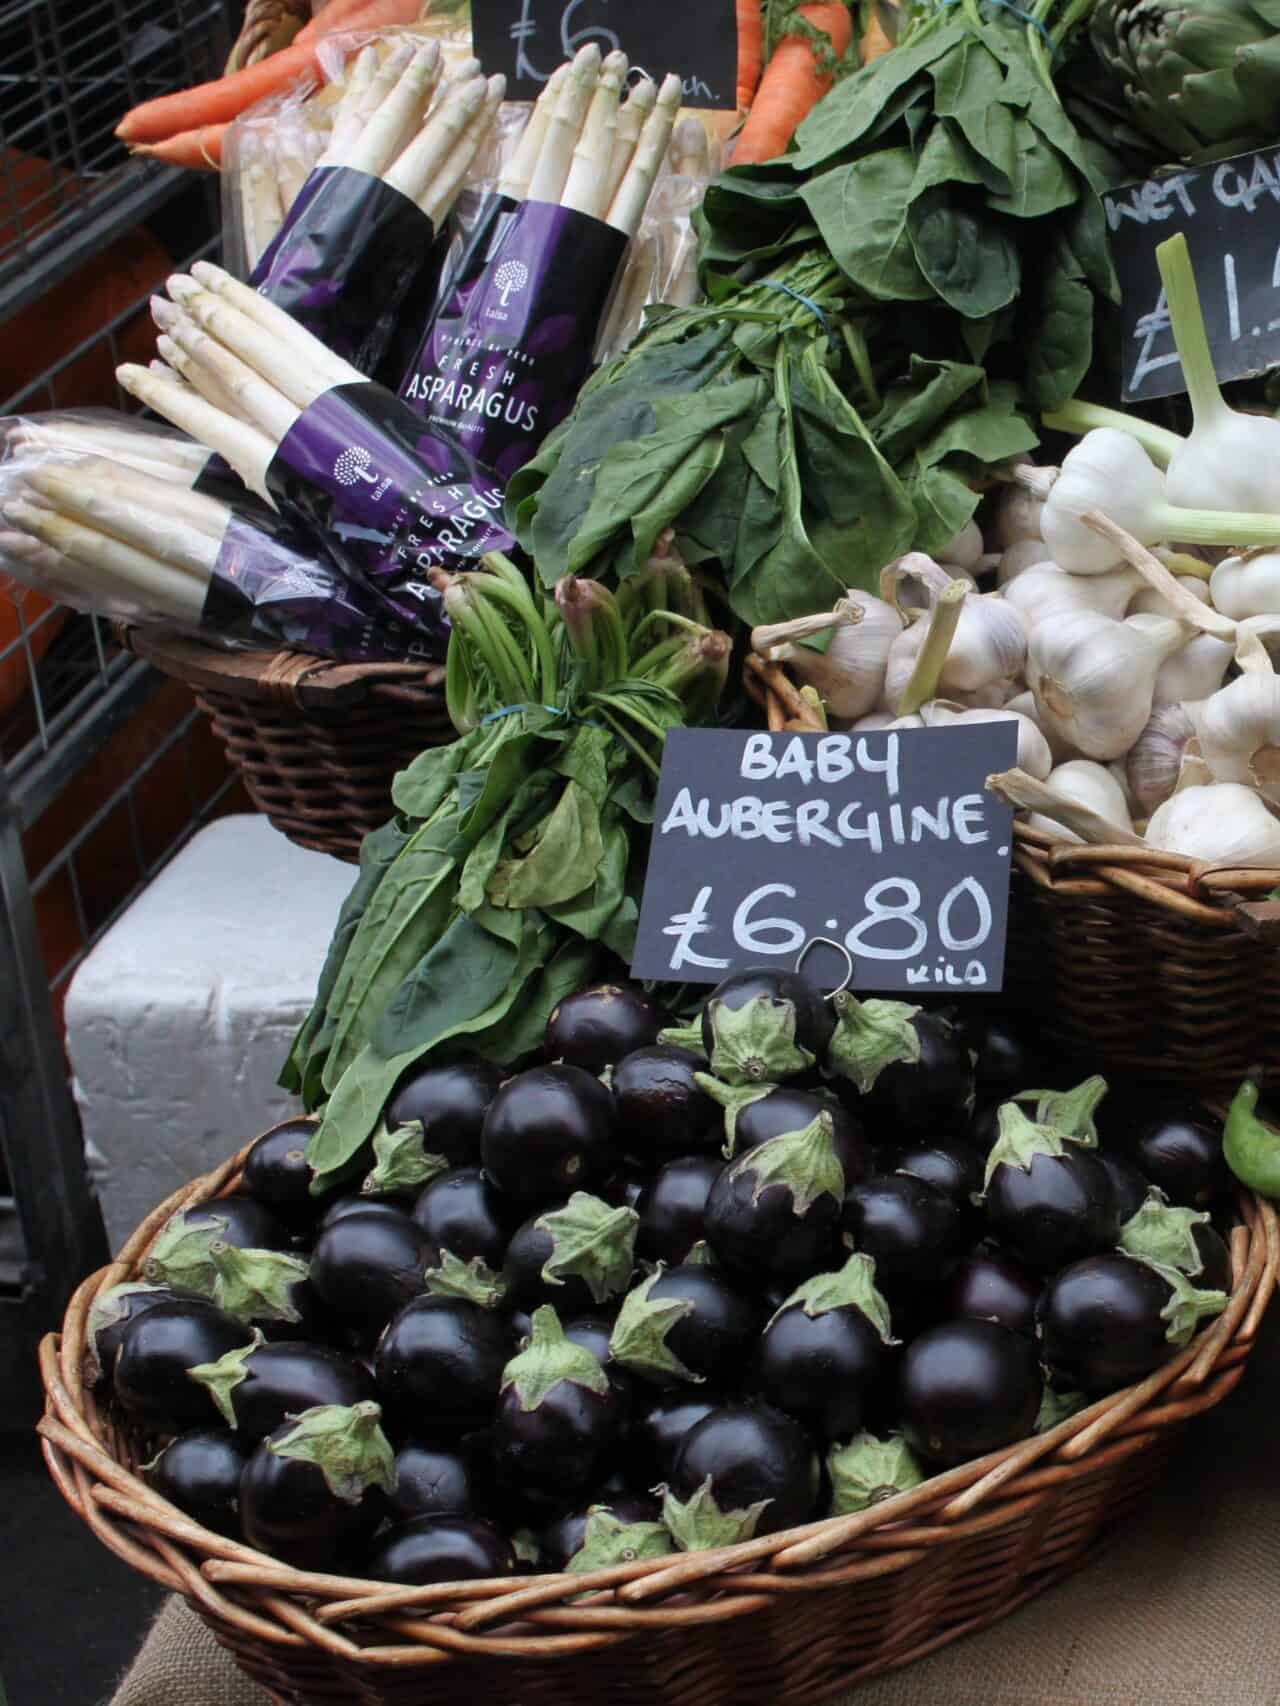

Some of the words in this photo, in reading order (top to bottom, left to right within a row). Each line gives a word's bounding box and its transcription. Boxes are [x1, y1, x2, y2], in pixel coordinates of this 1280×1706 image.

[406, 373, 539, 431] ASPARAGUS
[437, 355, 515, 386] FRESH
[398, 485, 464, 559] FRESH
[406, 487, 506, 601] APARAGU
[740, 731, 900, 796] BABY
[662, 876, 992, 970] £6.80
